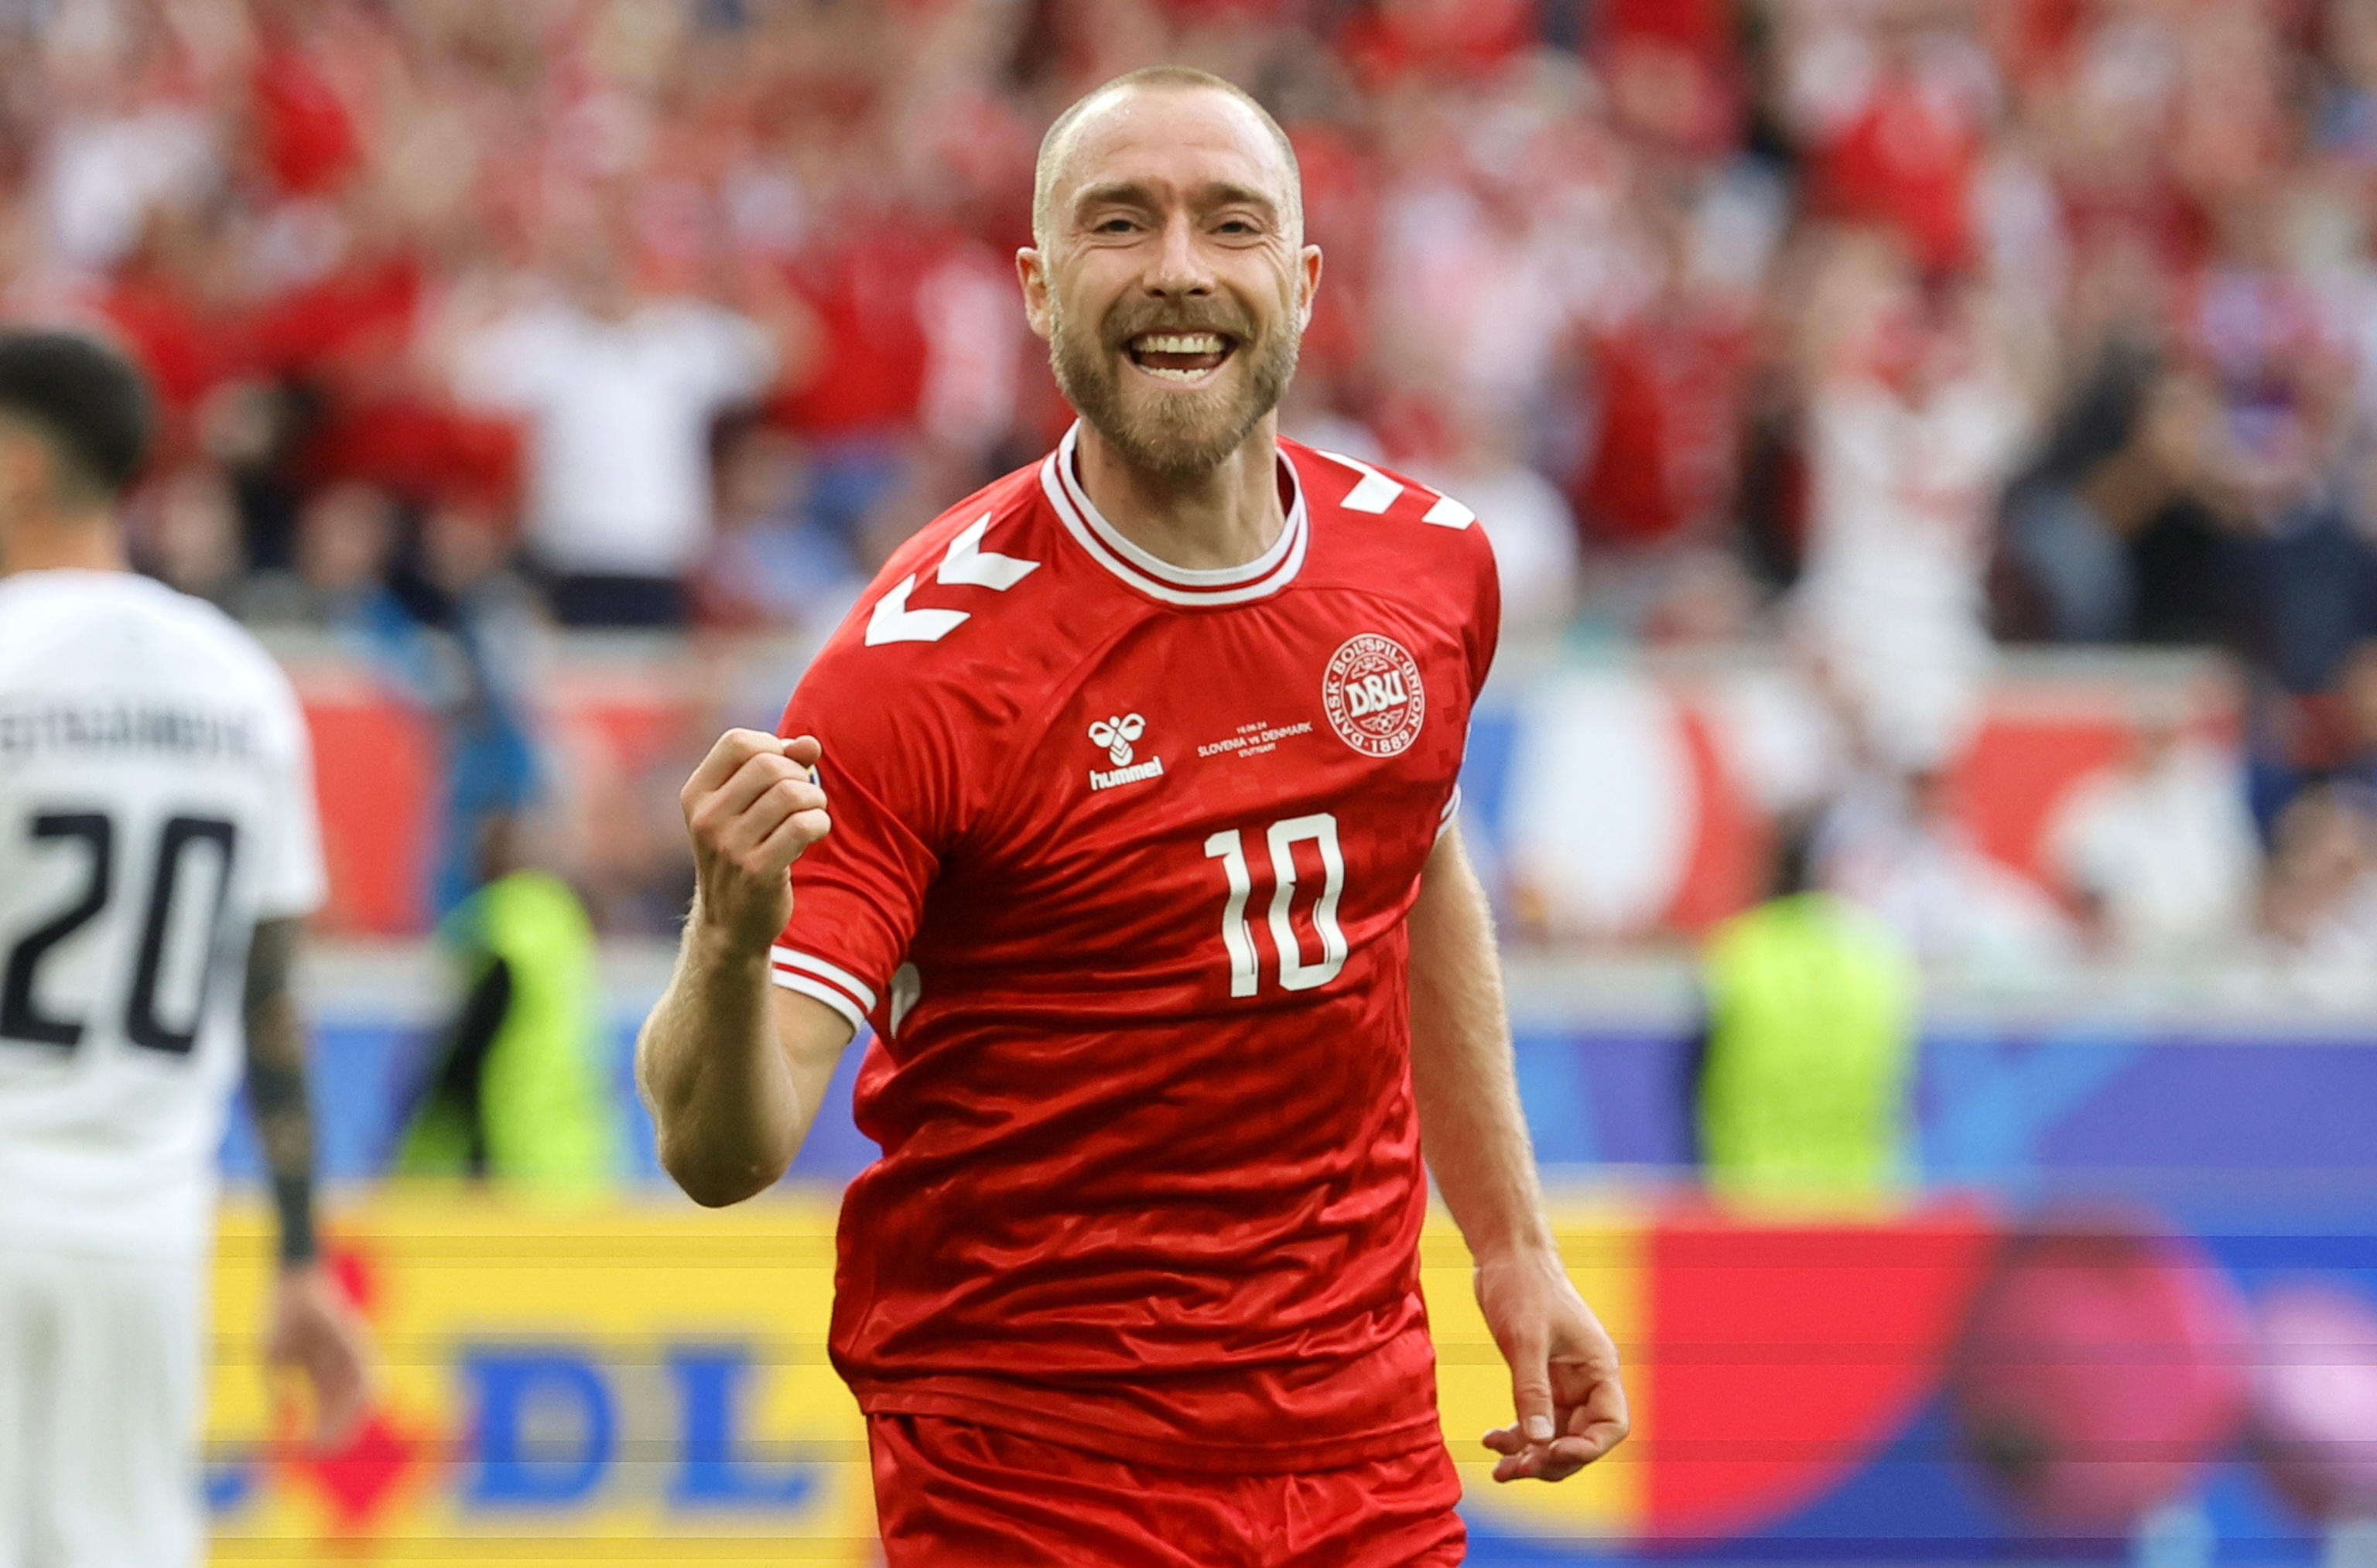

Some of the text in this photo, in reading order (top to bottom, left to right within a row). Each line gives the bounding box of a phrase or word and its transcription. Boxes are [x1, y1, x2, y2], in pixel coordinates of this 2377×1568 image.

[1326, 680, 1365, 747] DANSK
[1402, 661, 1422, 727] UNION
[1345, 670, 1408, 718] DBU
[1197, 736, 1247, 757] SLOVENIA
[1260, 721, 1313, 743] DENMARK
[1370, 729, 1410, 753] 1889
[1089, 755, 1164, 791] hummel
[1204, 812, 1349, 998] 10
[0, 815, 237, 1054] 20
